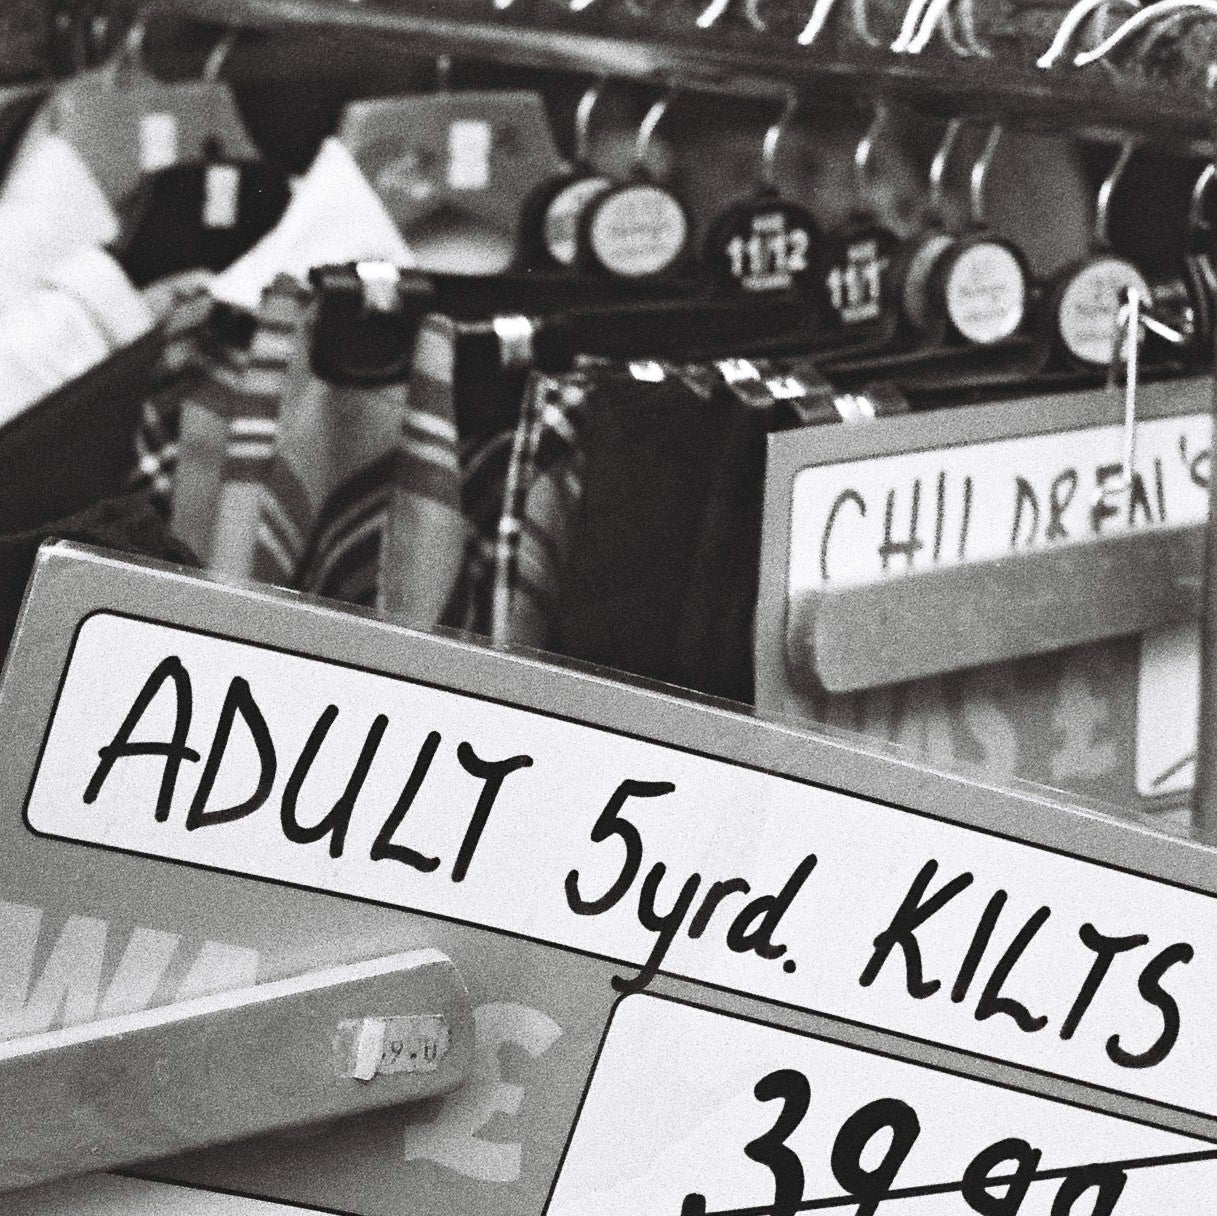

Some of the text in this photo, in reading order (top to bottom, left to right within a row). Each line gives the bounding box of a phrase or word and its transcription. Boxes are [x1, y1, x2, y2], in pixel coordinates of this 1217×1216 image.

[83, 655, 1195, 1069] ADULT 5yrd. KILTS
